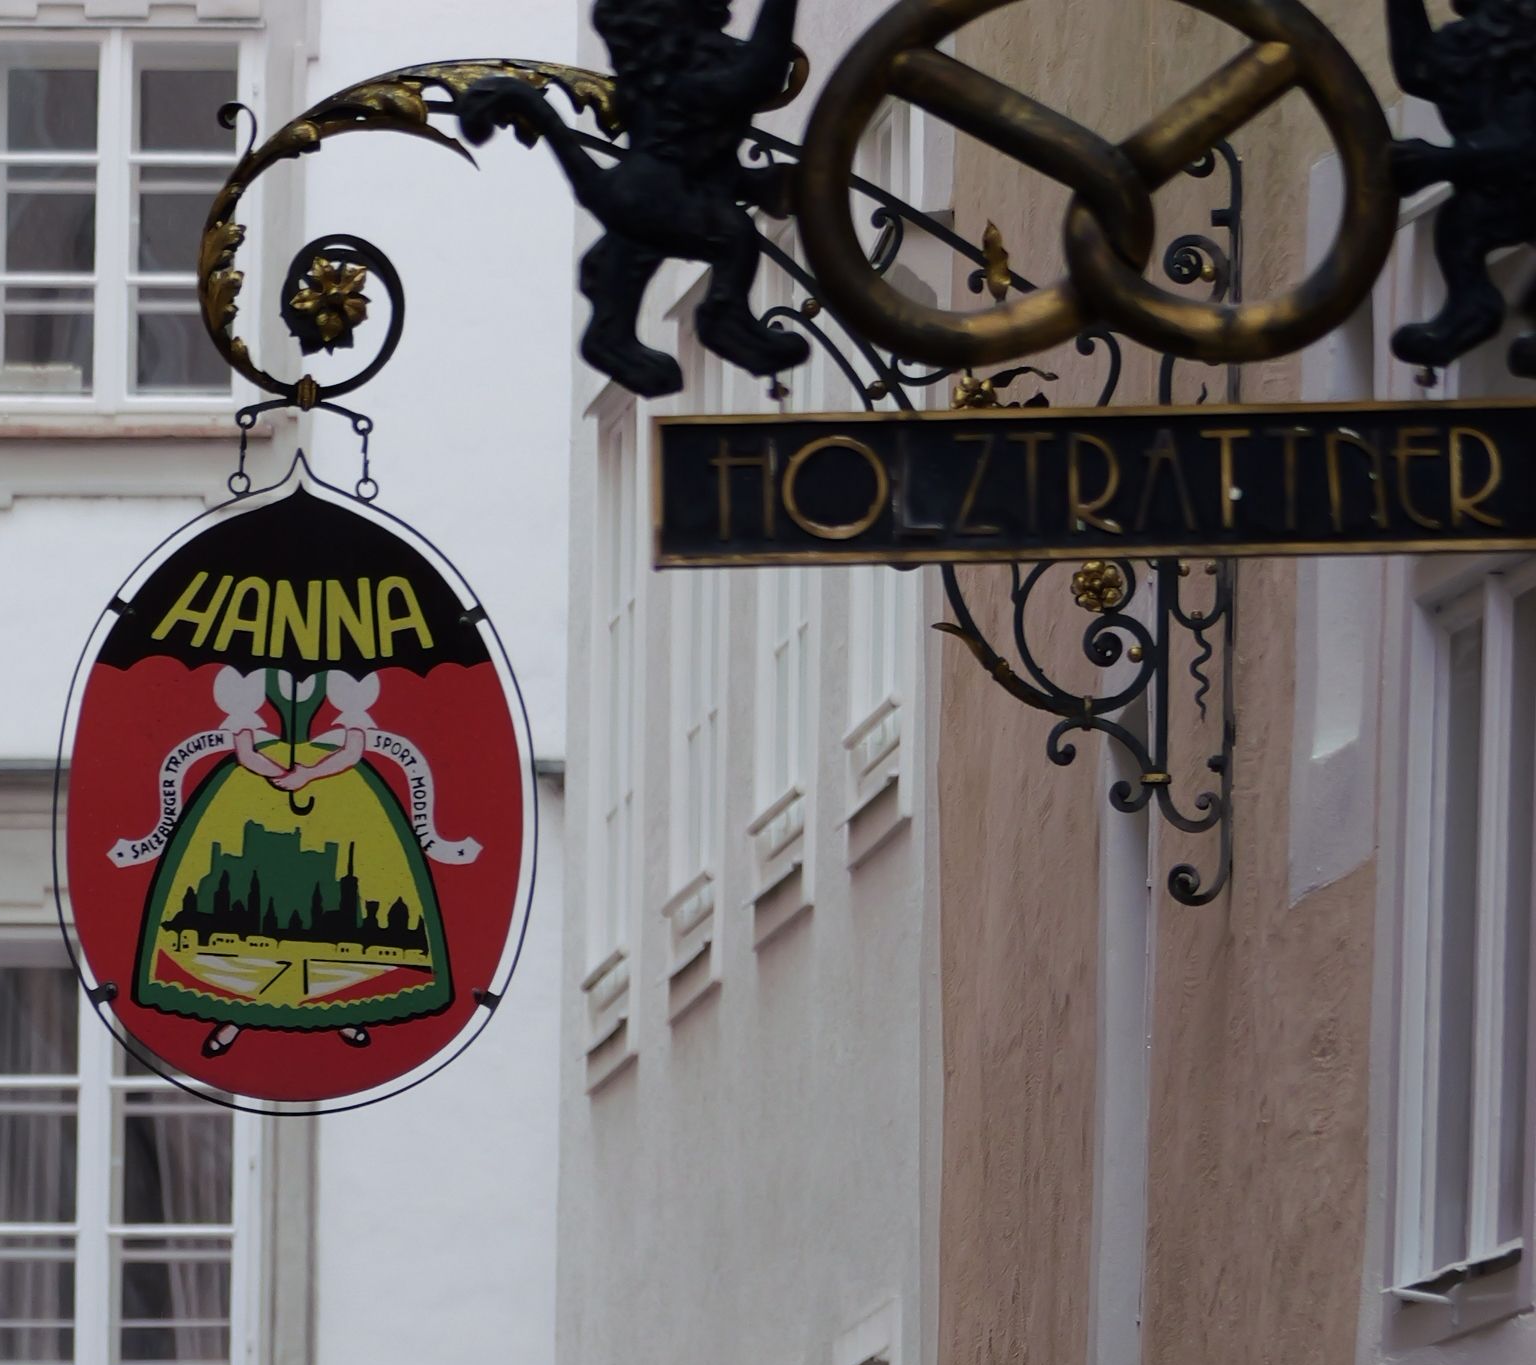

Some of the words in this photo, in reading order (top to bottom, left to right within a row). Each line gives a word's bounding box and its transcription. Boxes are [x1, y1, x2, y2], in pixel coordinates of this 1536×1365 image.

[710, 426, 1504, 541] HOLZTRATTNER
[151, 571, 434, 661] HANNA
[131, 779, 178, 860] SALZBURGER
[165, 733, 224, 774] TRACHTEN
[374, 735, 417, 767] SPORT
[411, 776, 435, 851] MODELLE
